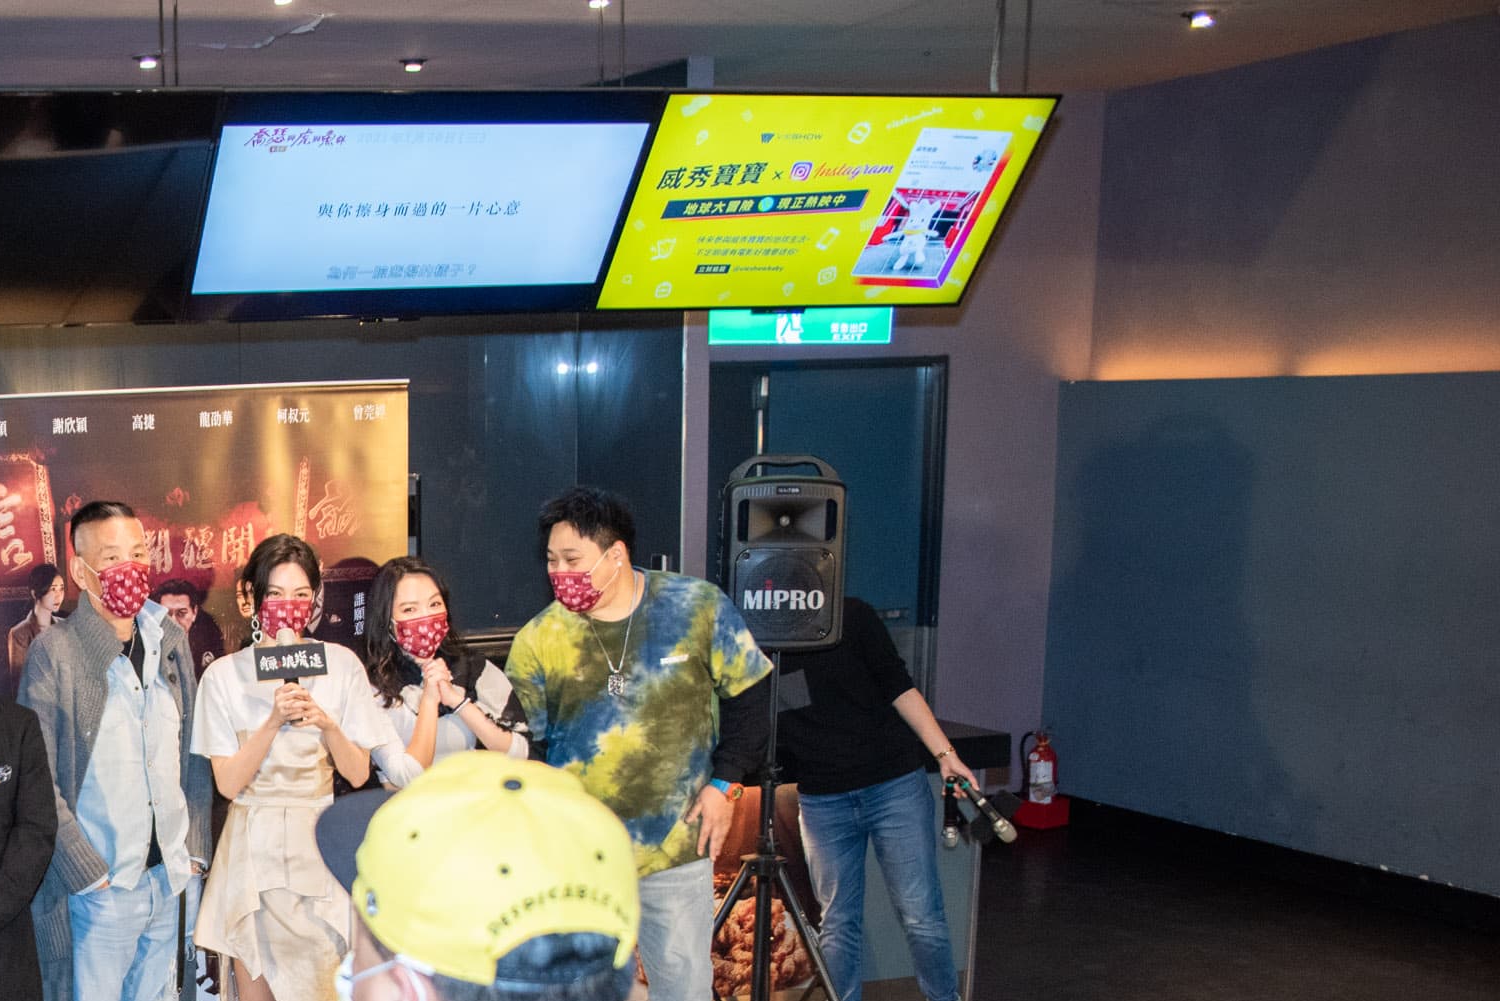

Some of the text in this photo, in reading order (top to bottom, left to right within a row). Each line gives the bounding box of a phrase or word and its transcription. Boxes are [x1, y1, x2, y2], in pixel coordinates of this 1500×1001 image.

[657, 162, 768, 190] 威秀寶寶
[814, 162, 894, 182] Instagram
[831, 333, 864, 341] EXIT
[132, 414, 155, 431] 高捷
[277, 406, 310, 424] 柯叔元
[743, 580, 825, 610] MIPRO
